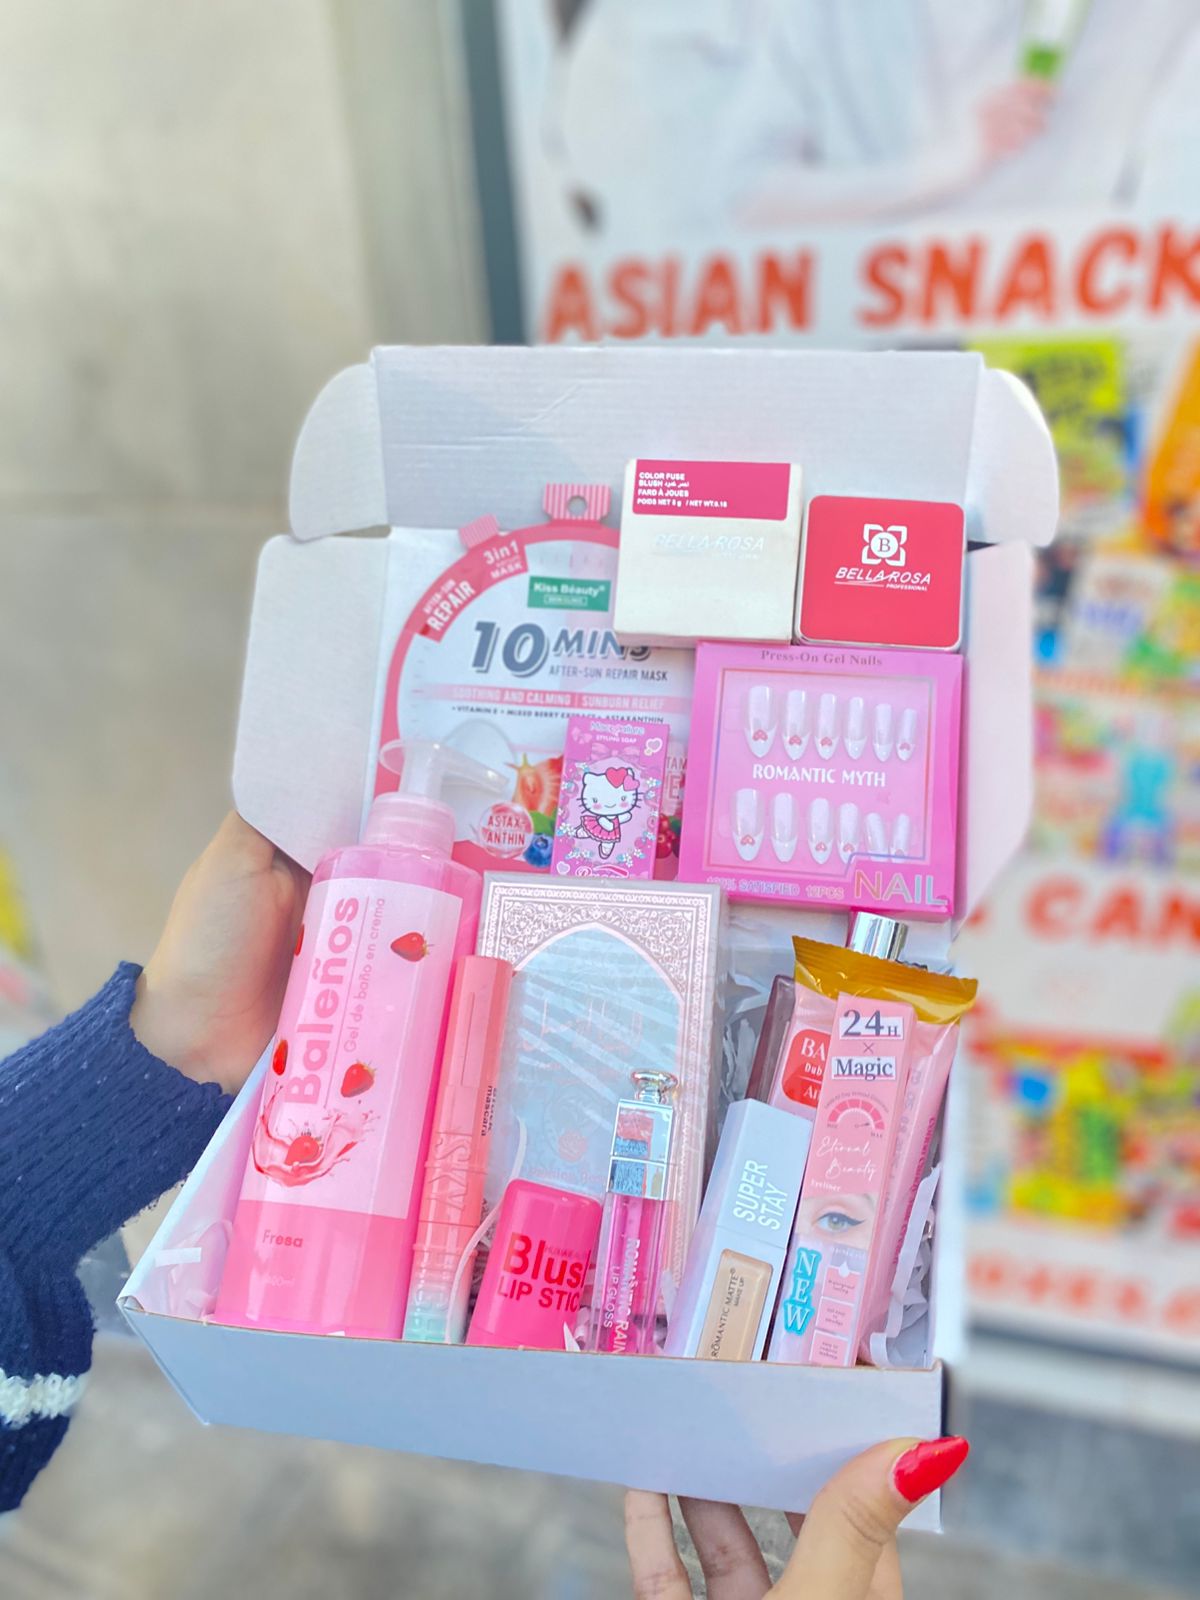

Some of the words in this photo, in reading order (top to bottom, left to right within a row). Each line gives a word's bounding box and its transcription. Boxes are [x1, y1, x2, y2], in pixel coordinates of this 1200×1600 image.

[543, 249, 818, 343] ASIAN
[857, 225, 1200, 328] SNACK
[638, 471, 665, 480] COLOR
[666, 472, 686, 480] FUSE
[638, 488, 657, 496] FARD
[878, 537, 891, 553] B
[533, 581, 558, 593] Kiss
[426, 580, 477, 632] REPAIR
[471, 620, 551, 678] 10
[761, 650, 818, 663] Press-On
[823, 653, 845, 665] Gel
[850, 655, 882, 666] Nails
[549, 664, 602, 679] AFTER-SUN
[605, 668, 638, 681] REPAIR
[640, 669, 668, 682] MASK
[752, 763, 836, 784] ROMANTIC
[841, 770, 886, 788] MYTH
[487, 831, 525, 846] ANTHIN
[854, 869, 948, 906] NAIL
[371, 898, 385, 940] crema
[365, 943, 376, 960] en
[354, 964, 372, 1000] baño
[284, 897, 359, 1105] Baleños
[352, 1005, 364, 1022] de
[344, 1026, 359, 1053] Gel
[835, 1058, 894, 1081] Magic
[480, 1085, 494, 1137] mascara
[733, 1159, 769, 1223] SUPER
[757, 1182, 788, 1230] STAY
[262, 1229, 304, 1248] Fresa
[497, 1275, 533, 1301] LIP
[610, 1265, 620, 1285] LIP
[786, 1250, 818, 1331] NEW
[603, 1287, 618, 1329] GLOSS
